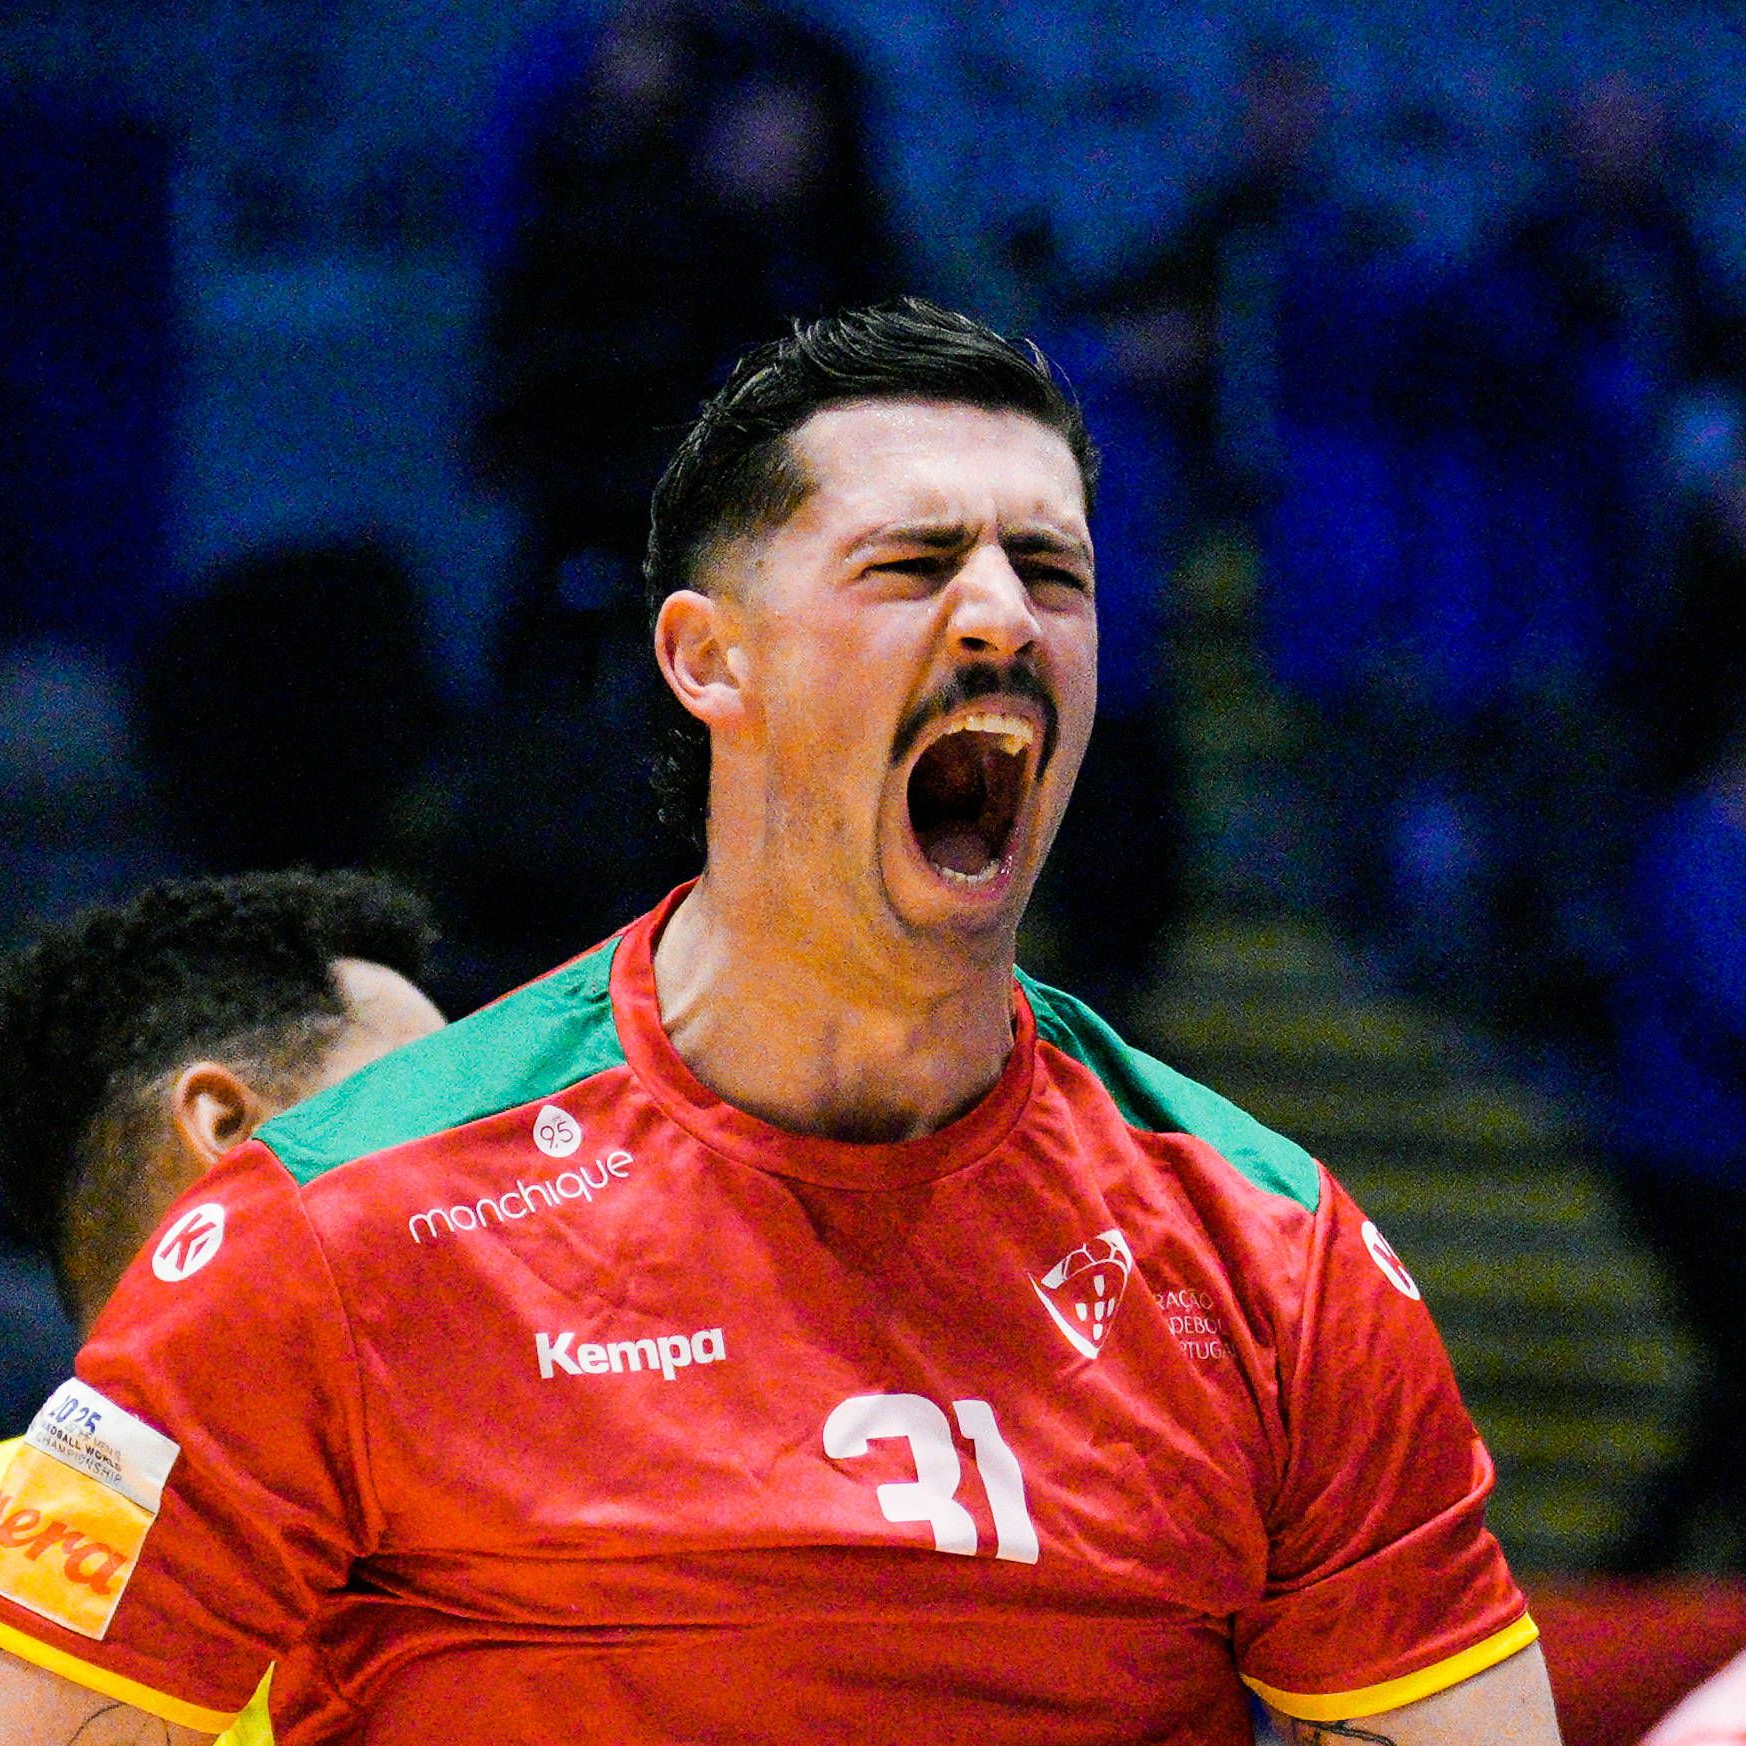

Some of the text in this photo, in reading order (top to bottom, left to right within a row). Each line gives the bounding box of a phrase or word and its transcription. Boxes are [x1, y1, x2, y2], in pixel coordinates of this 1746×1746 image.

[408, 1150, 635, 1244] monchique
[535, 1328, 727, 1381] Kempa
[823, 1393, 1039, 1565] 31
